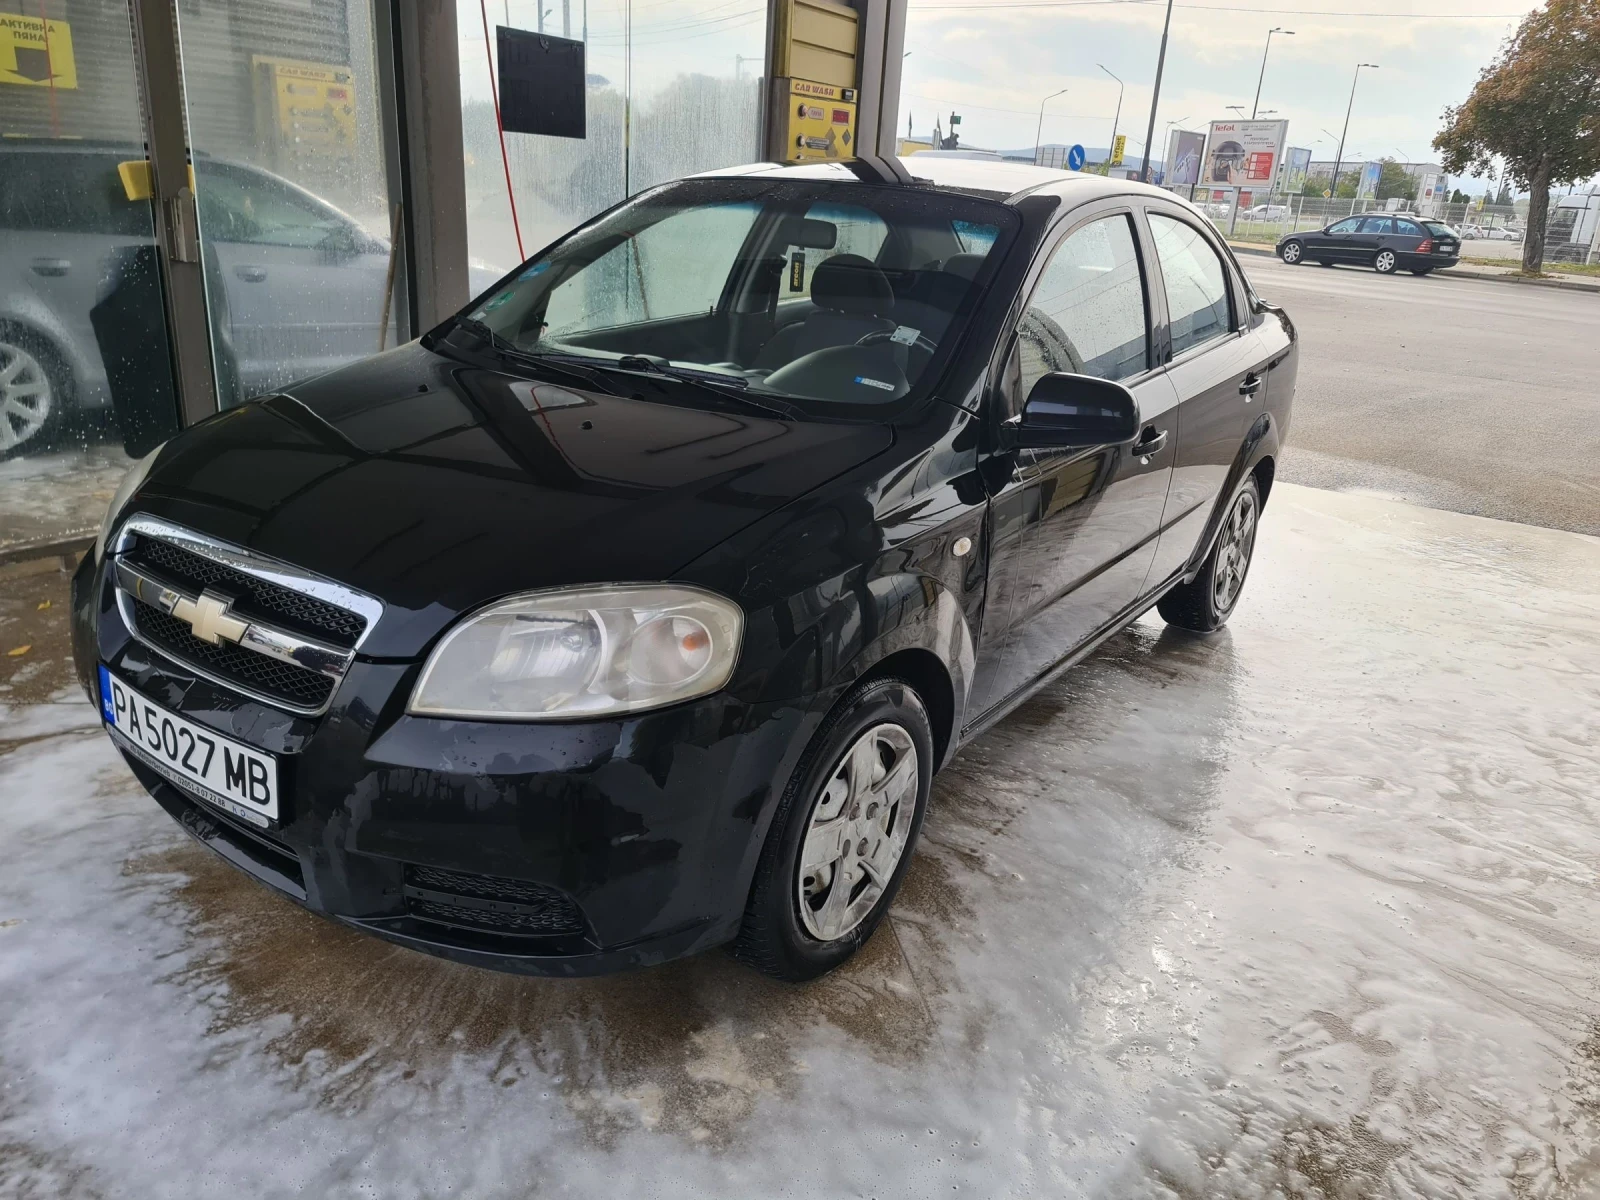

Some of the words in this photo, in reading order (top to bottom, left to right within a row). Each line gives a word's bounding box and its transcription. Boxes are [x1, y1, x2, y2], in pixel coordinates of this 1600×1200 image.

[0, 18, 55, 33] АКТИВНА
[13, 31, 46, 42] ПЯНА
[795, 83, 811, 93] CAR
[812, 86, 834, 96] WASH
[1215, 124, 1235, 132] Tefal
[104, 698, 114, 715] BG
[112, 681, 143, 741] PA
[144, 705, 215, 779] 5027
[224, 746, 270, 806] MB
